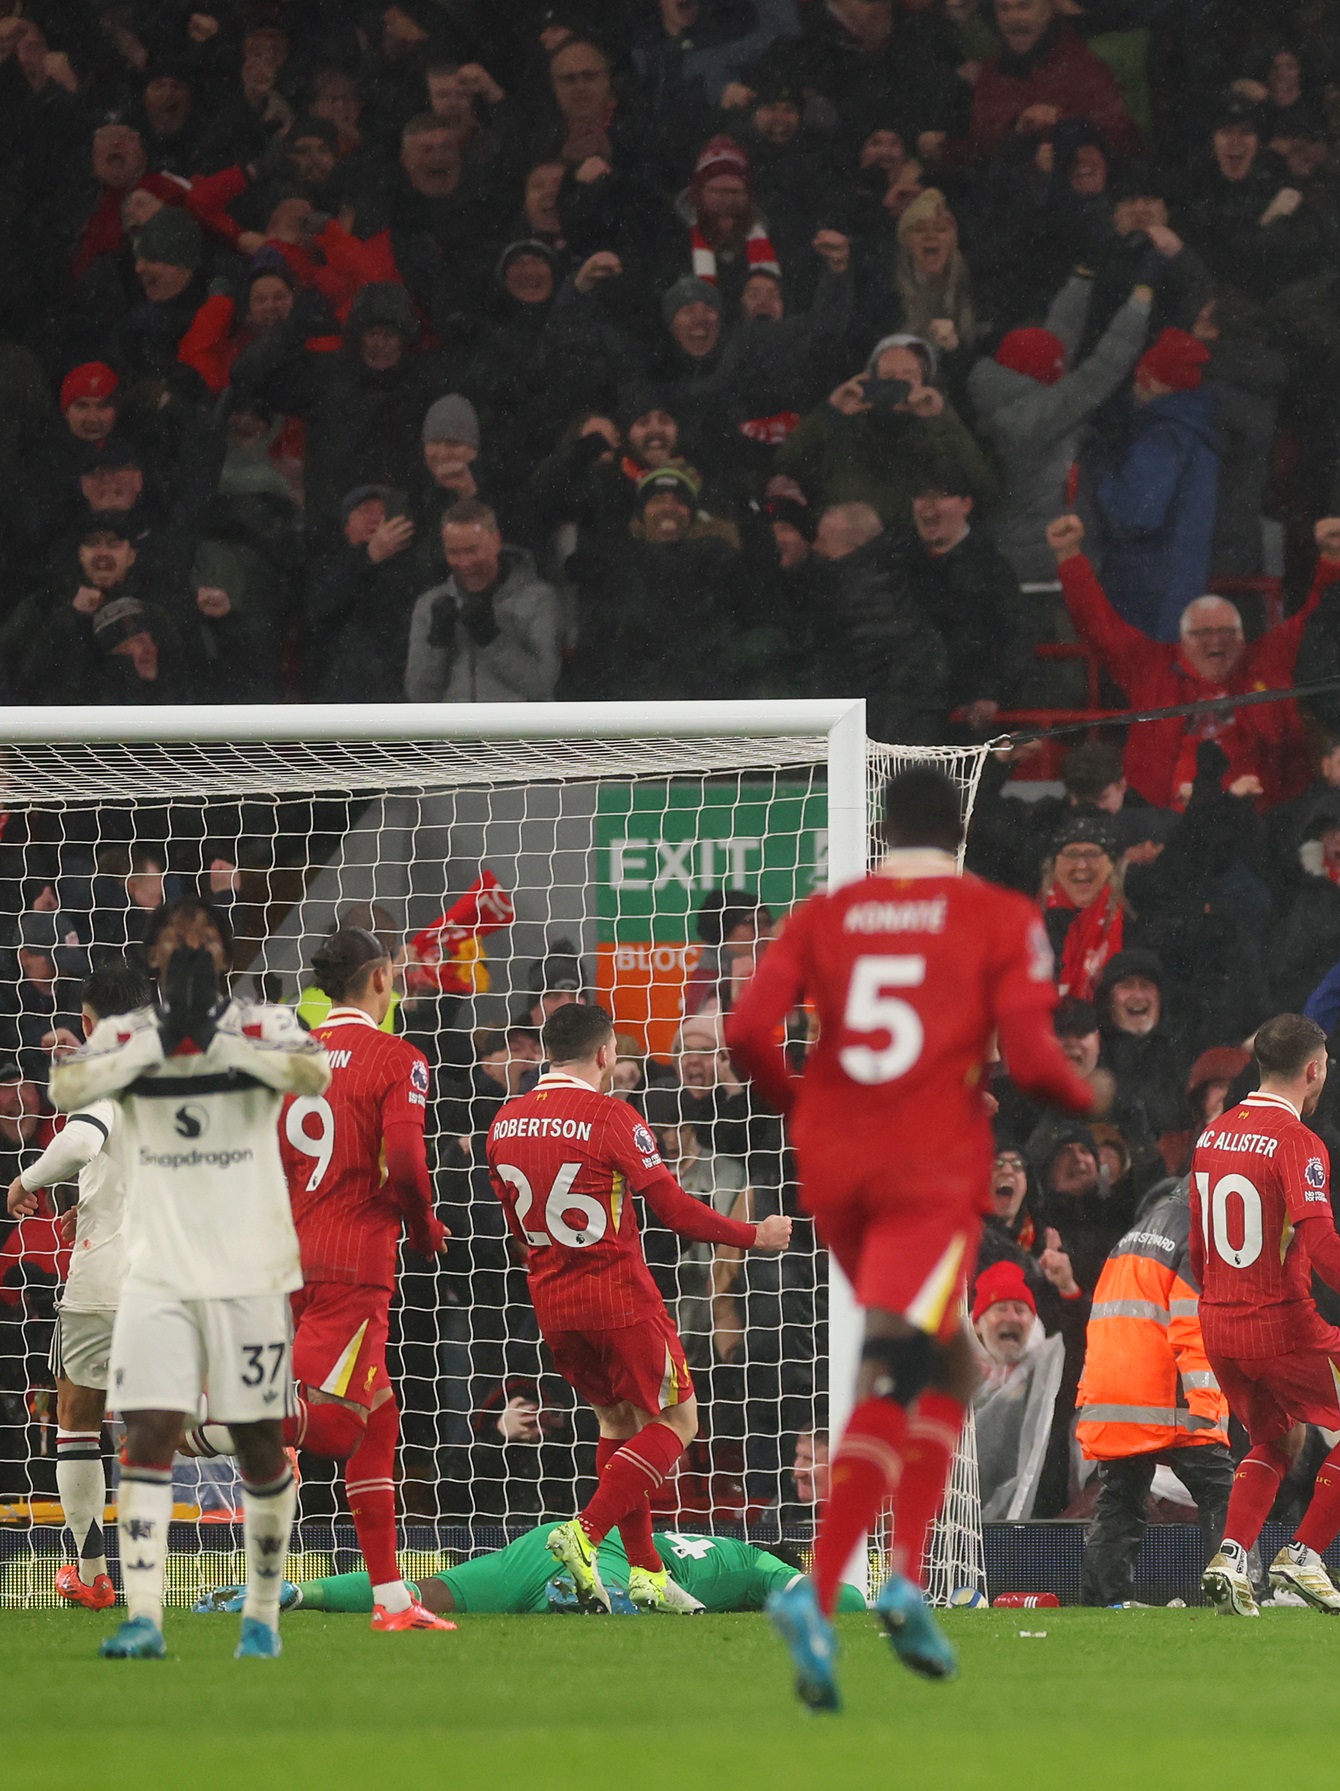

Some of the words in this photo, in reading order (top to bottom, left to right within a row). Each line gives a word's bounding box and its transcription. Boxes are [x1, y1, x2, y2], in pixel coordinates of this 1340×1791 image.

[609, 838, 758, 890] EXIT
[616, 947, 699, 972] BLOC
[839, 954, 927, 1086] 5
[286, 1095, 335, 1191] 9
[493, 1118, 592, 1142] ROBERTSON
[1213, 1131, 1279, 1158] ALLISTER
[138, 1146, 254, 1170] Snapdragon
[496, 1163, 607, 1248] 26
[1194, 1172, 1264, 1269] 10
[241, 1343, 286, 1388] 37
